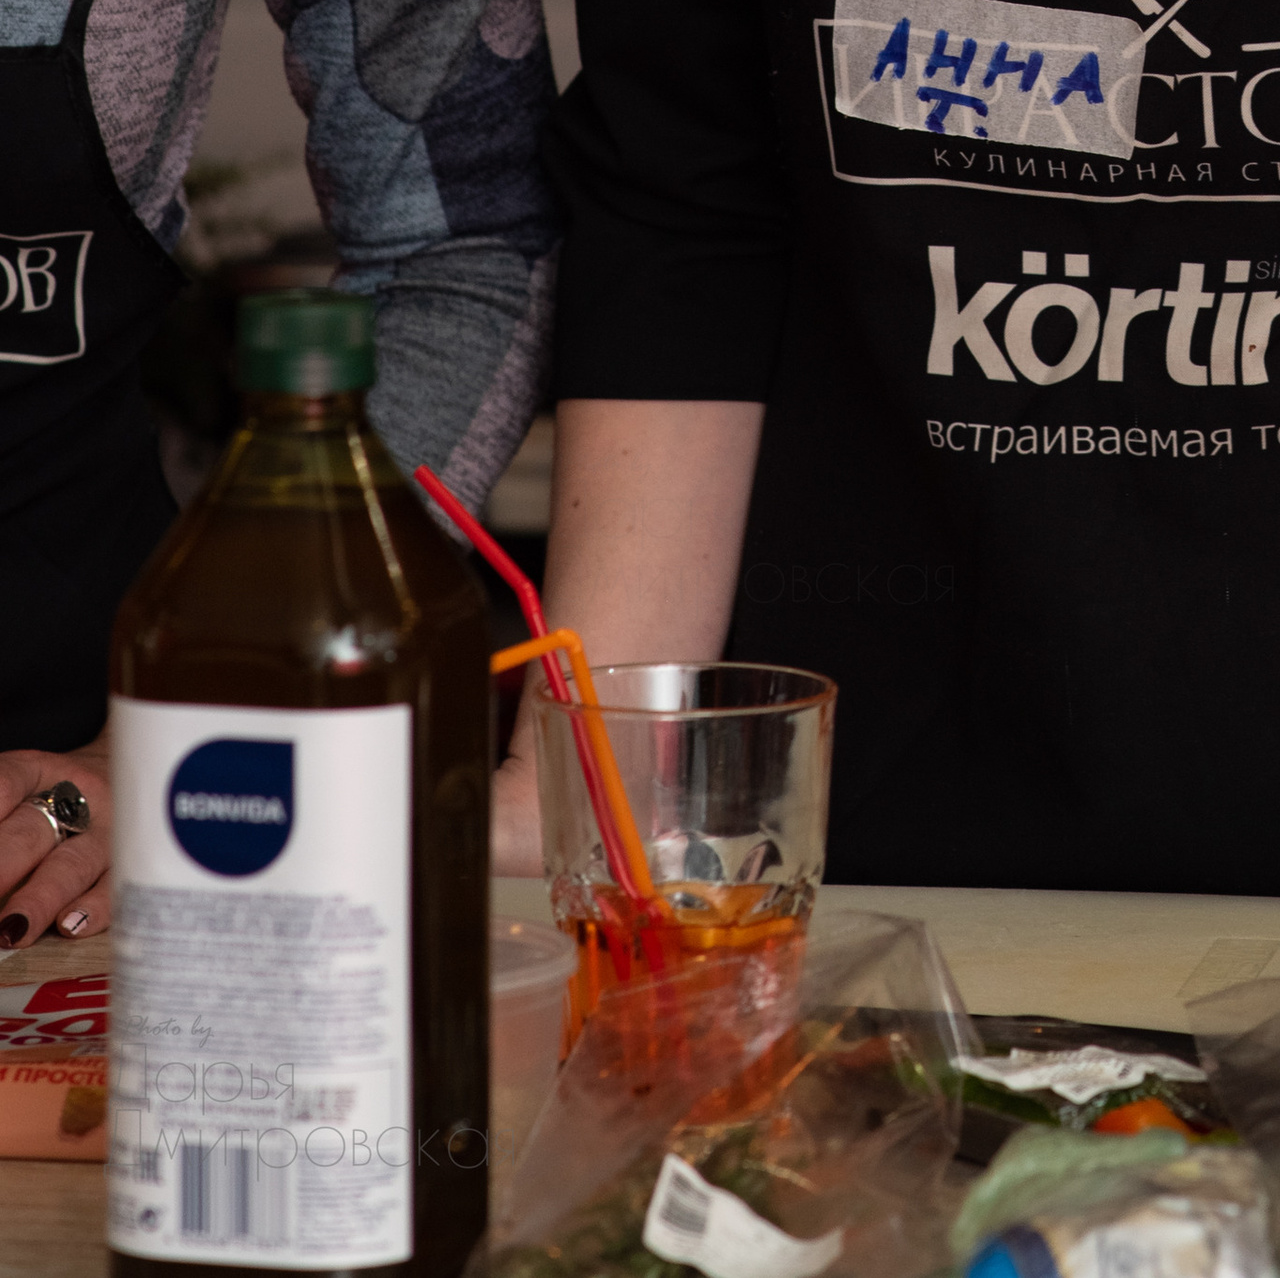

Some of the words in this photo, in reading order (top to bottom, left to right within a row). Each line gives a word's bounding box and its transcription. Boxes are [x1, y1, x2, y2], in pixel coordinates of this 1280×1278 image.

[870, 17, 1104, 105] АННА
[933, 147, 1213, 184] КУЛИНАРНАЯ
[926, 419, 1234, 464] встраиваемая
